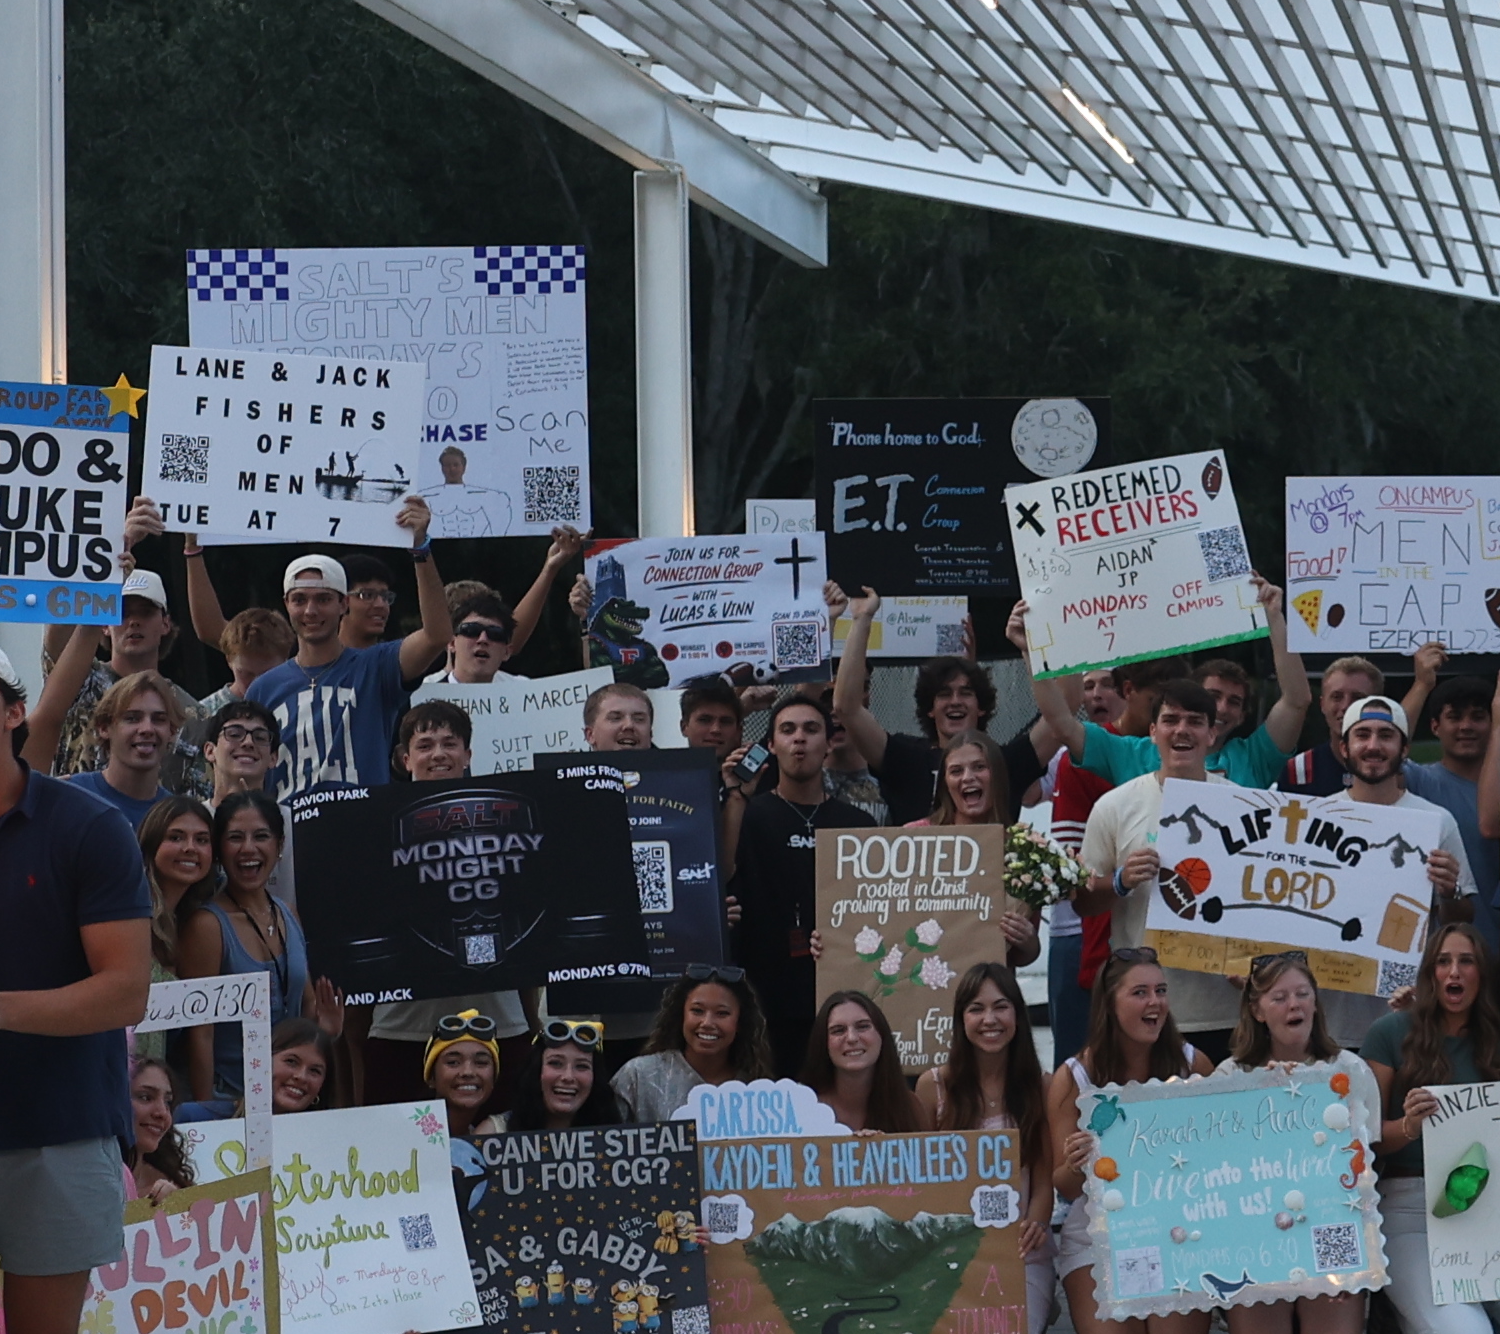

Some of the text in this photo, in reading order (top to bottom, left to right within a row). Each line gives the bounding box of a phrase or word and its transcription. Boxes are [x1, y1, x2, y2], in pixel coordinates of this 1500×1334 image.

[298, 255, 464, 300] SALT'S
[231, 295, 547, 344] MIGHTY MEN
[176, 356, 390, 389] LANE & JACK
[196, 397, 386, 430] FISHERS
[257, 434, 293, 454] OF
[77, 438, 124, 484] &
[238, 471, 303, 494] MEN
[1052, 465, 1181, 513] REDEEMED
[833, 474, 914, 534] E.T.
[1057, 490, 1198, 546] RECEIVERS
[664, 546, 740, 563] JOIN US FOR
[1352, 520, 1471, 565] MEN
[644, 562, 763, 584] CONNECTION GROUP
[1118, 571, 1138, 588] JP
[46, 586, 117, 617] 6PM
[692, 590, 717, 601] WITH
[1172, 580, 1202, 599] OFF
[1360, 583, 1461, 625] GAP
[660, 601, 755, 624] LUCAS & VINN
[1063, 594, 1147, 623] MONDAYS
[1166, 595, 1223, 617] CAMPUS
[292, 788, 369, 809] SAVION PARK
[392, 833, 545, 867] MONDAY
[837, 834, 985, 880] ROOTED.
[1265, 851, 1307, 866] FOR THE
[418, 856, 525, 883] NIGHT
[448, 879, 499, 903] CG
[857, 876, 968, 898] rooted in Christ.
[1241, 865, 1336, 910] LORD
[482, 1125, 694, 1165] CAN WE STEAL
[556, 1227, 669, 1279] GABBY
